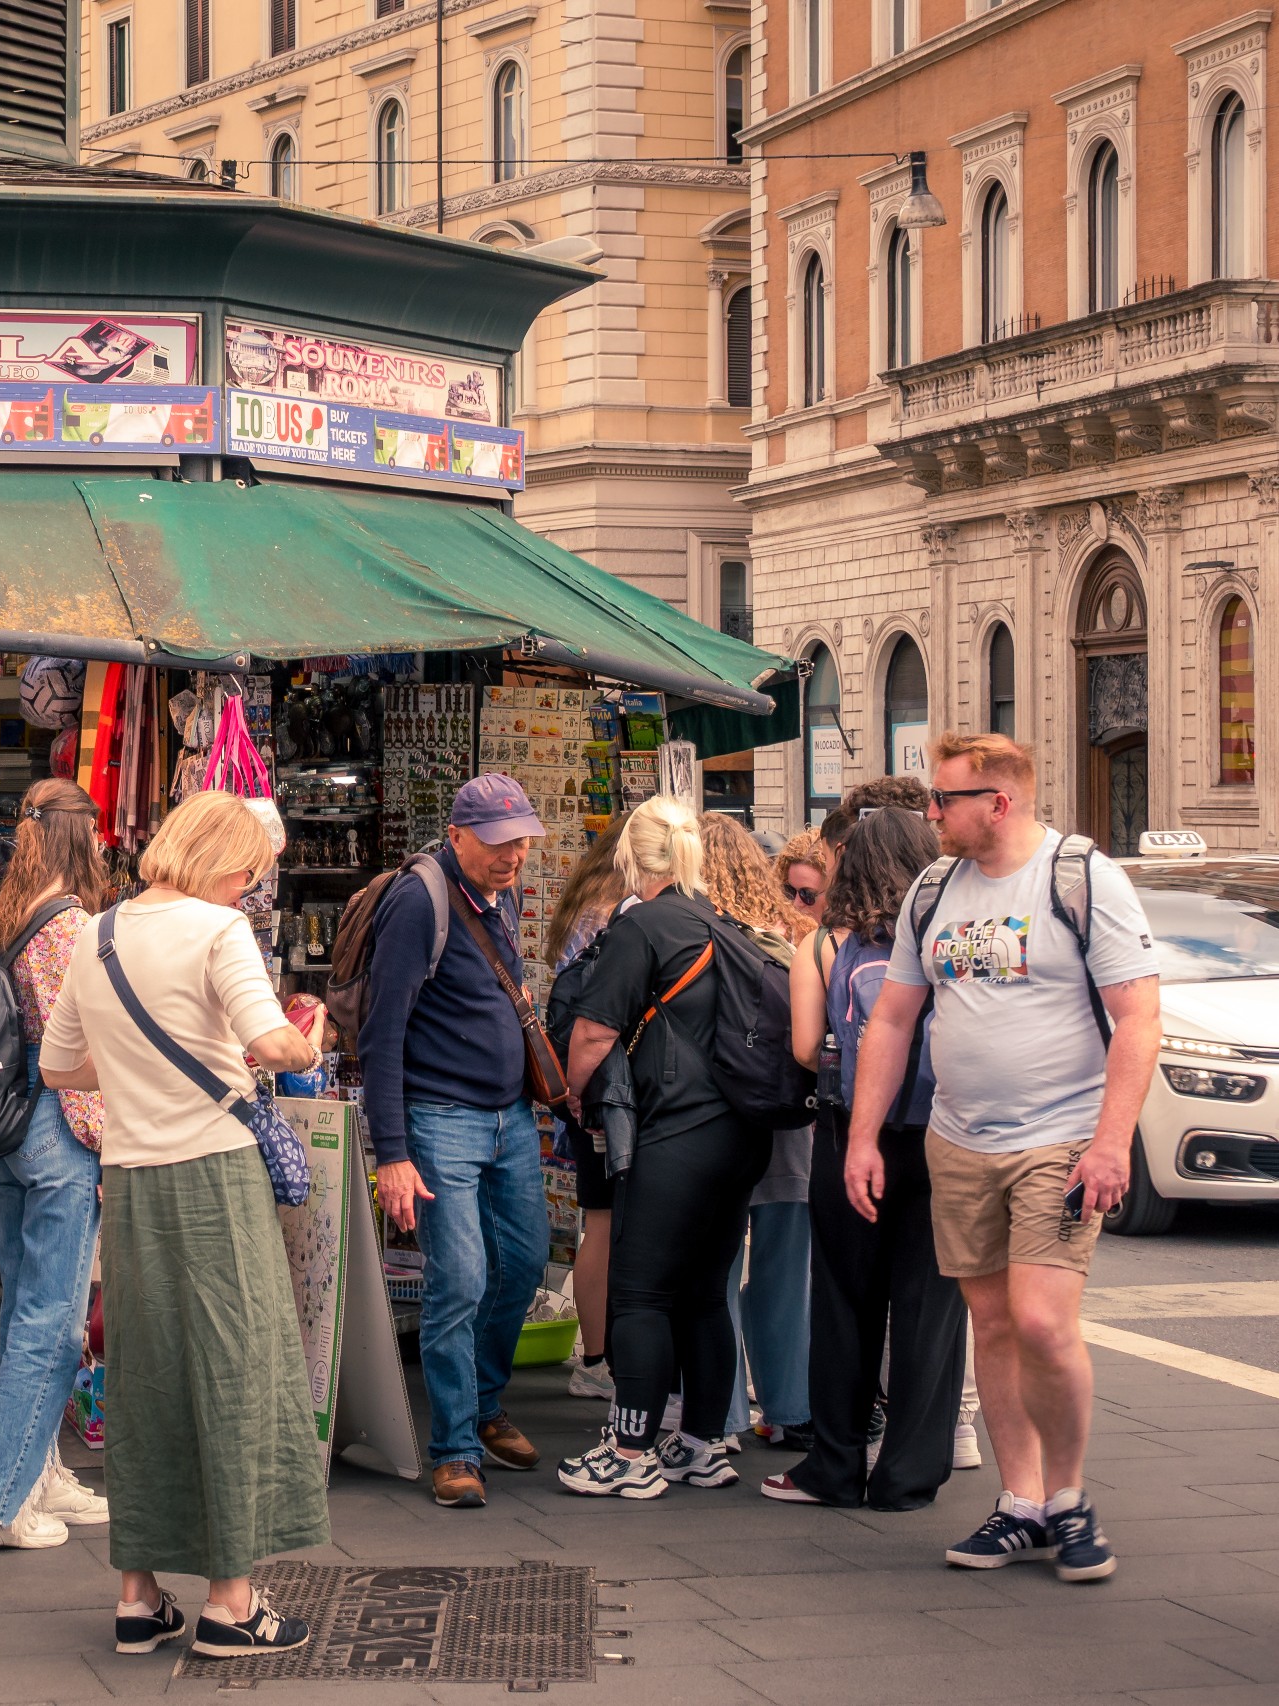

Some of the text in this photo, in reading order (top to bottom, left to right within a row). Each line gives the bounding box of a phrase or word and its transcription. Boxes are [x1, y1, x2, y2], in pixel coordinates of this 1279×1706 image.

[284, 337, 447, 388] SOUVENIRS
[323, 373, 396, 407] ROMA
[236, 396, 303, 443] IOBUS
[330, 409, 350, 424] BUY
[330, 428, 367, 445] TICKETS
[231, 440, 328, 462] MADE TO SHOW YOU ITALY
[331, 447, 356, 462] HERE
[625, 699, 643, 707] Italia
[591, 711, 612, 720] РИМ
[622, 760, 647, 771] METRO
[815, 763, 822, 774] 06
[623, 776, 654, 786] ROMA
[588, 785, 608, 793] ROM
[1148, 833, 1201, 845] TAXI
[965, 925, 995, 940] THE
[936, 939, 992, 958] NORTH
[952, 953, 994, 971] FACE
[256, 1615, 280, 1642] N
